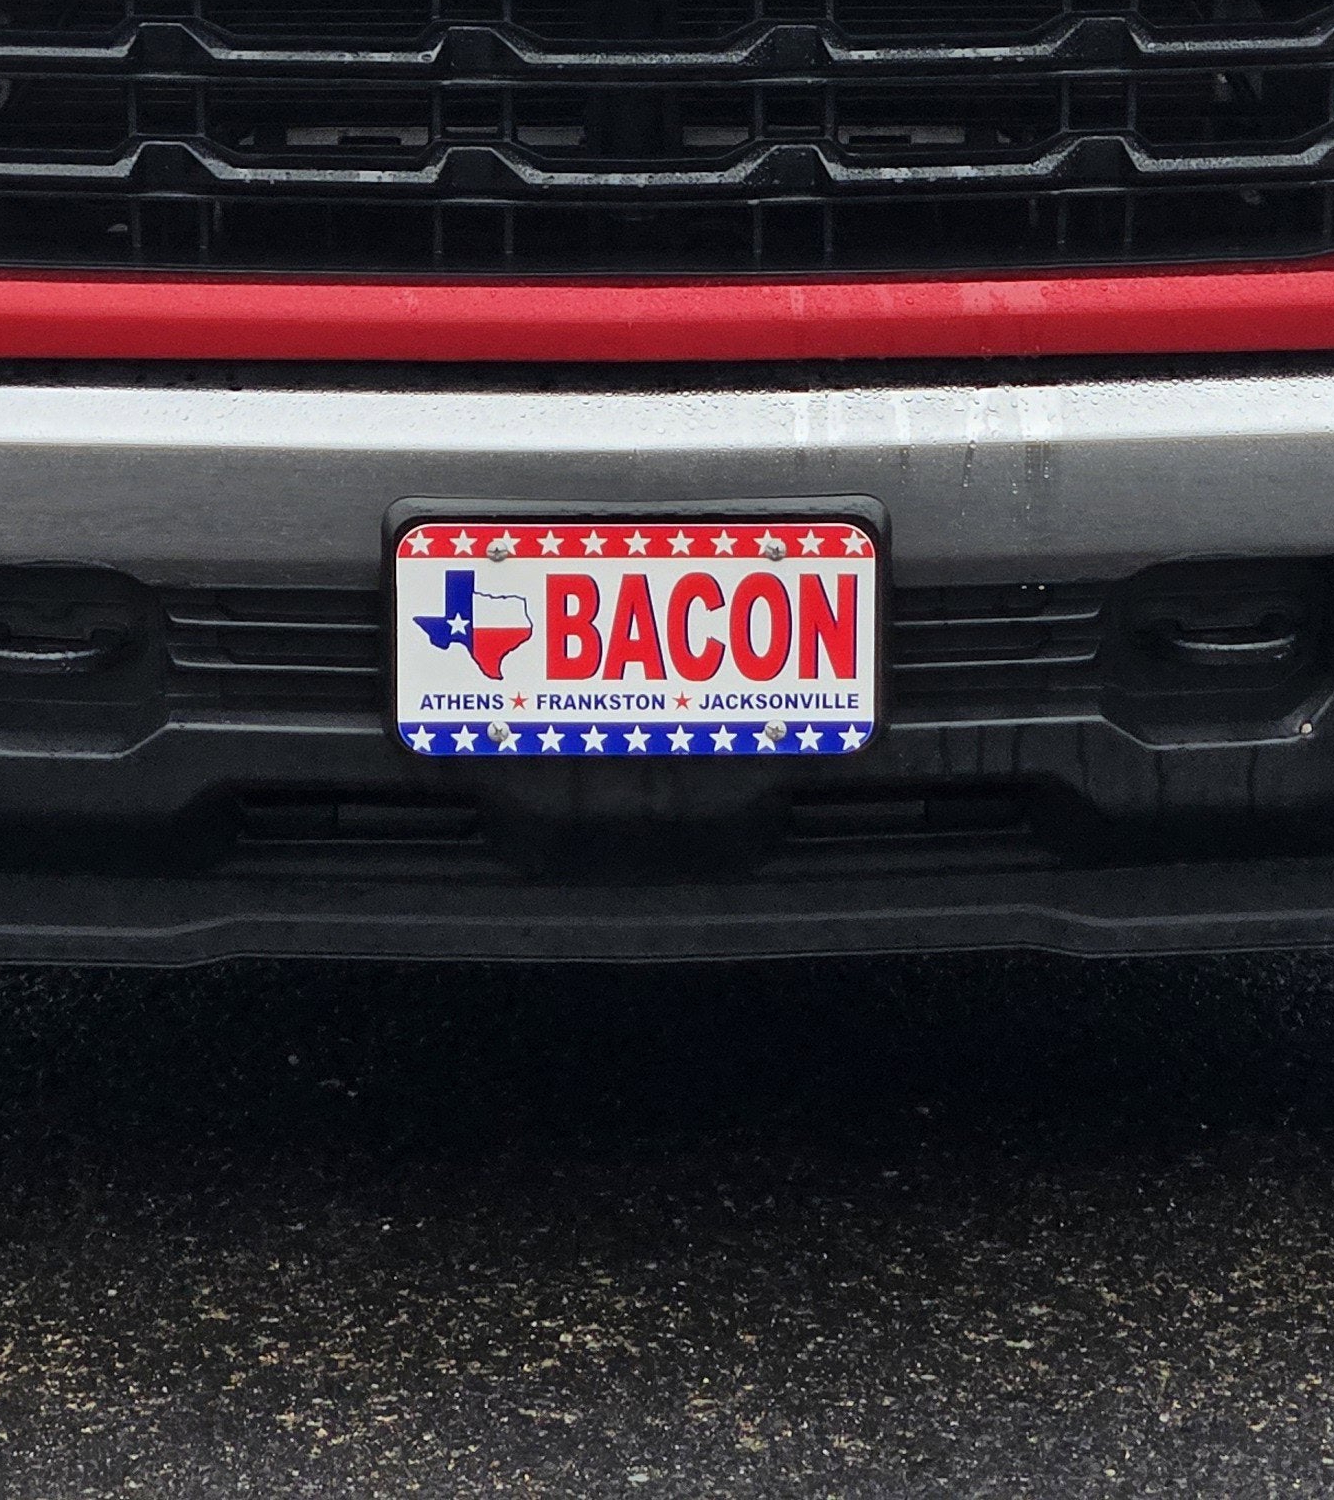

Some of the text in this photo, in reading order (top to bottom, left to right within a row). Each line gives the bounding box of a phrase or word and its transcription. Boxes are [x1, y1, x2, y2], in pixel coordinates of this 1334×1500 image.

[546, 571, 858, 682] BACON
[420, 693, 859, 711] ATHENS FRANKSTON JACKSONVILLE
